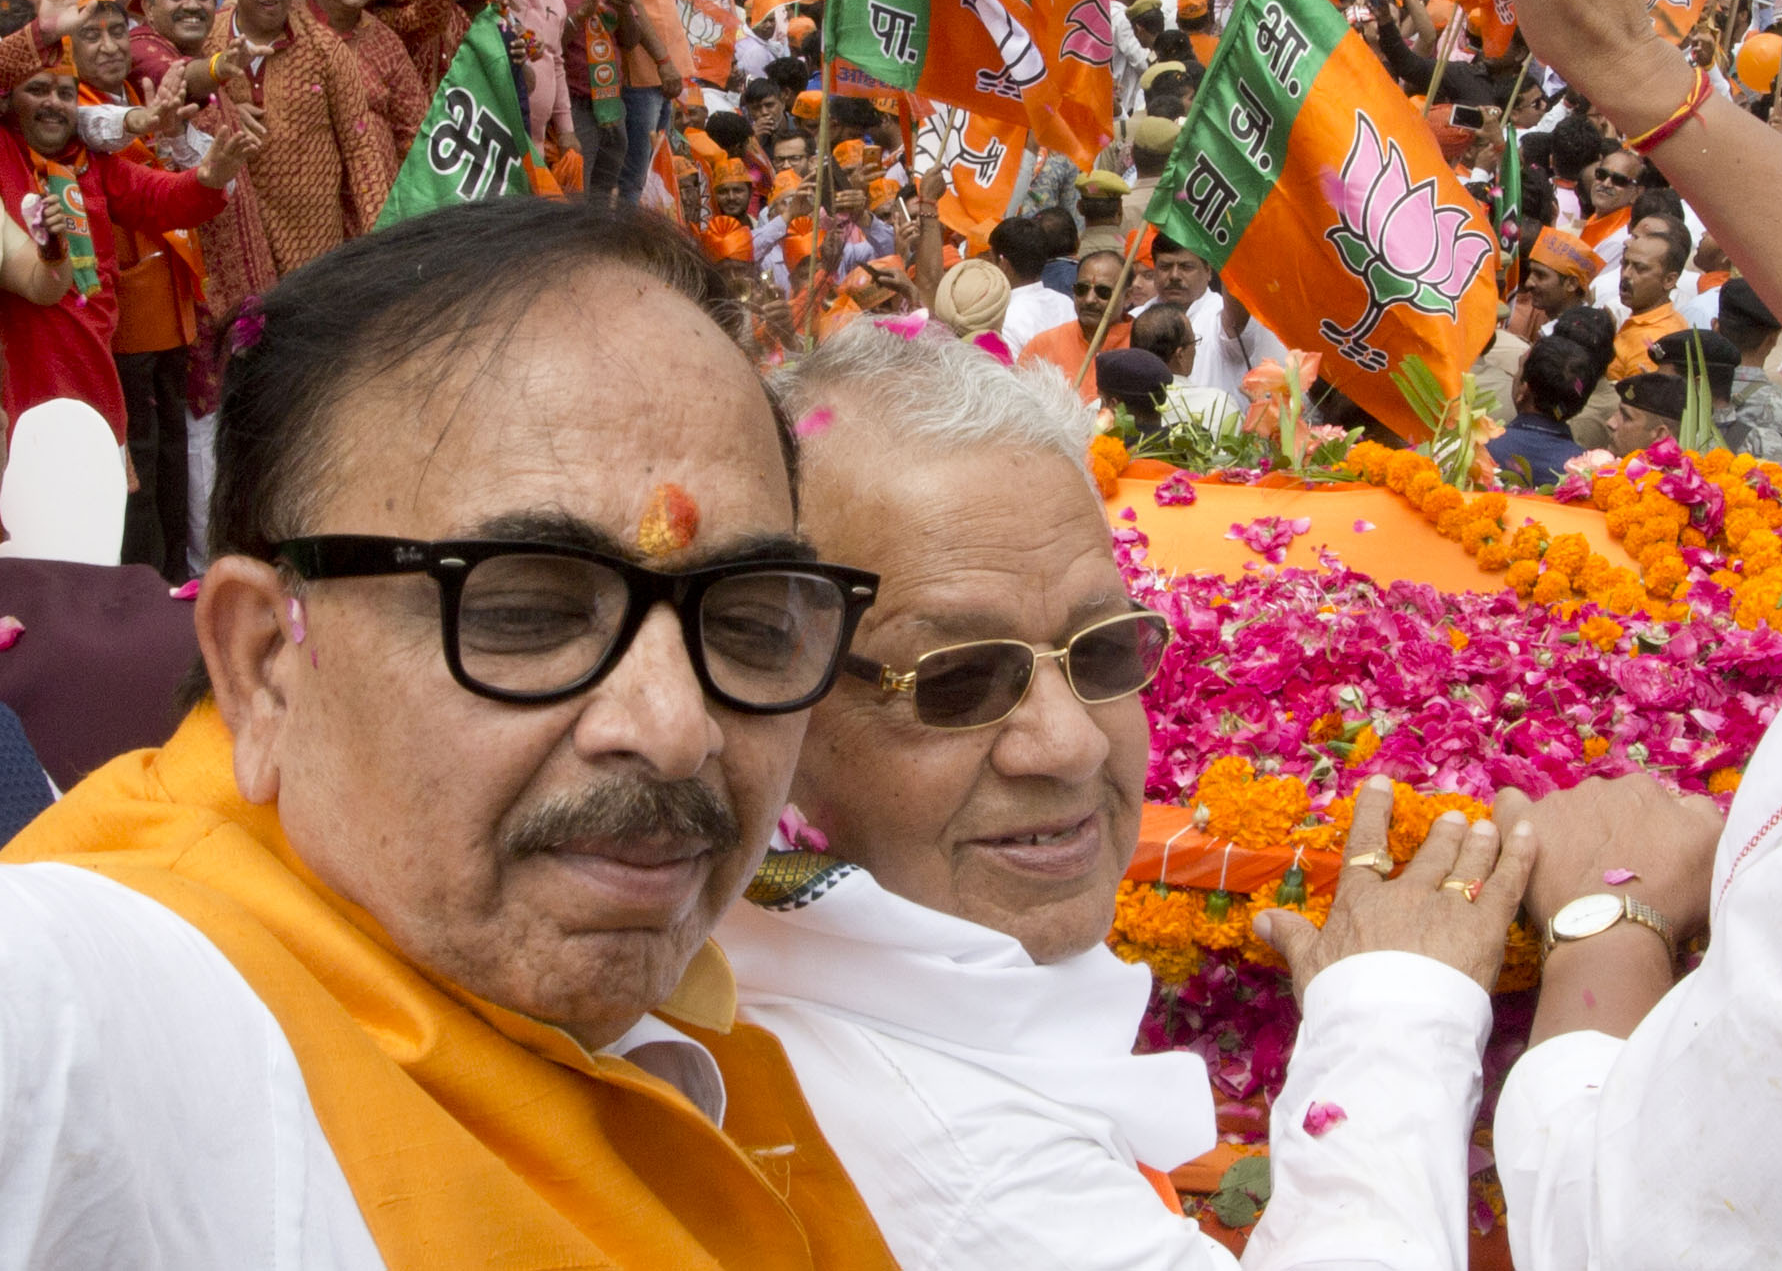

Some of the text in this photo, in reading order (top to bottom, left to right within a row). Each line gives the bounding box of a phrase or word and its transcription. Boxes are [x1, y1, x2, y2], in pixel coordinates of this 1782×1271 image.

[1184, 1, 1312, 246] भा. ज. पा.
